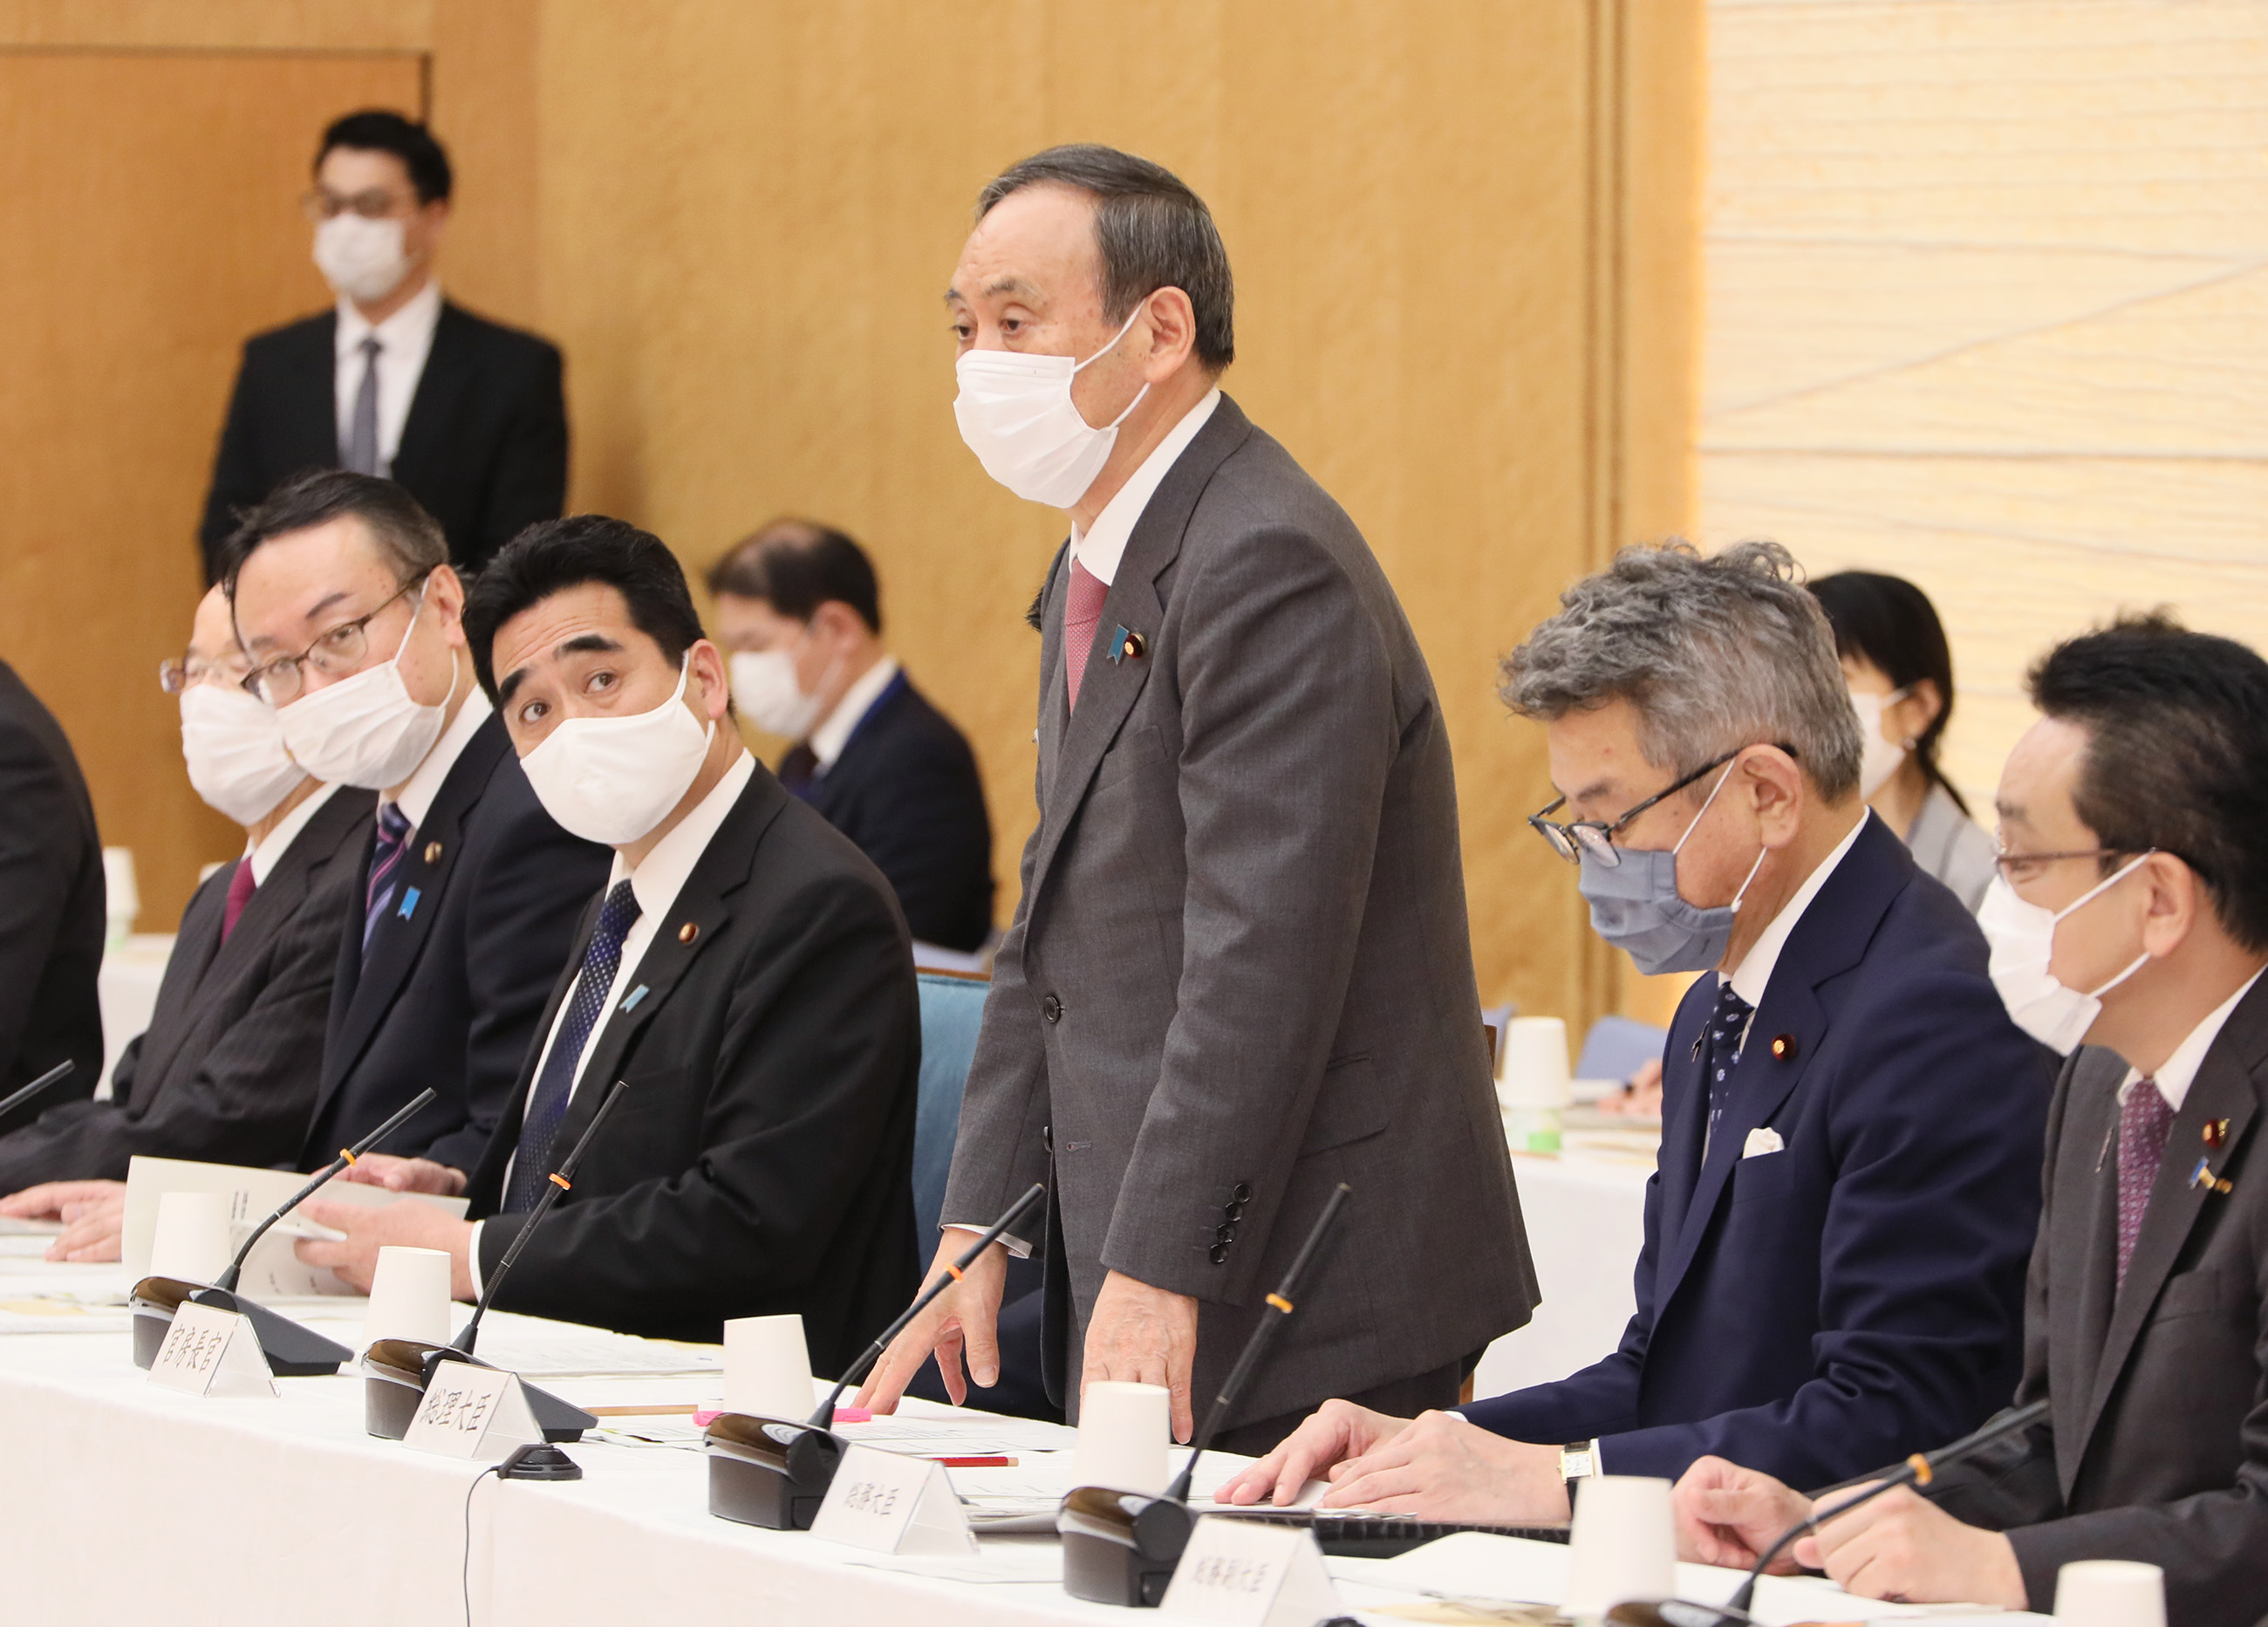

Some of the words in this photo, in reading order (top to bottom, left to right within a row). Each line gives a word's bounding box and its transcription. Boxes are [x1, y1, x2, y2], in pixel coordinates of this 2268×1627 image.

[163, 1323, 222, 1373] 官房長官
[420, 1388, 491, 1434] 総理大臣
